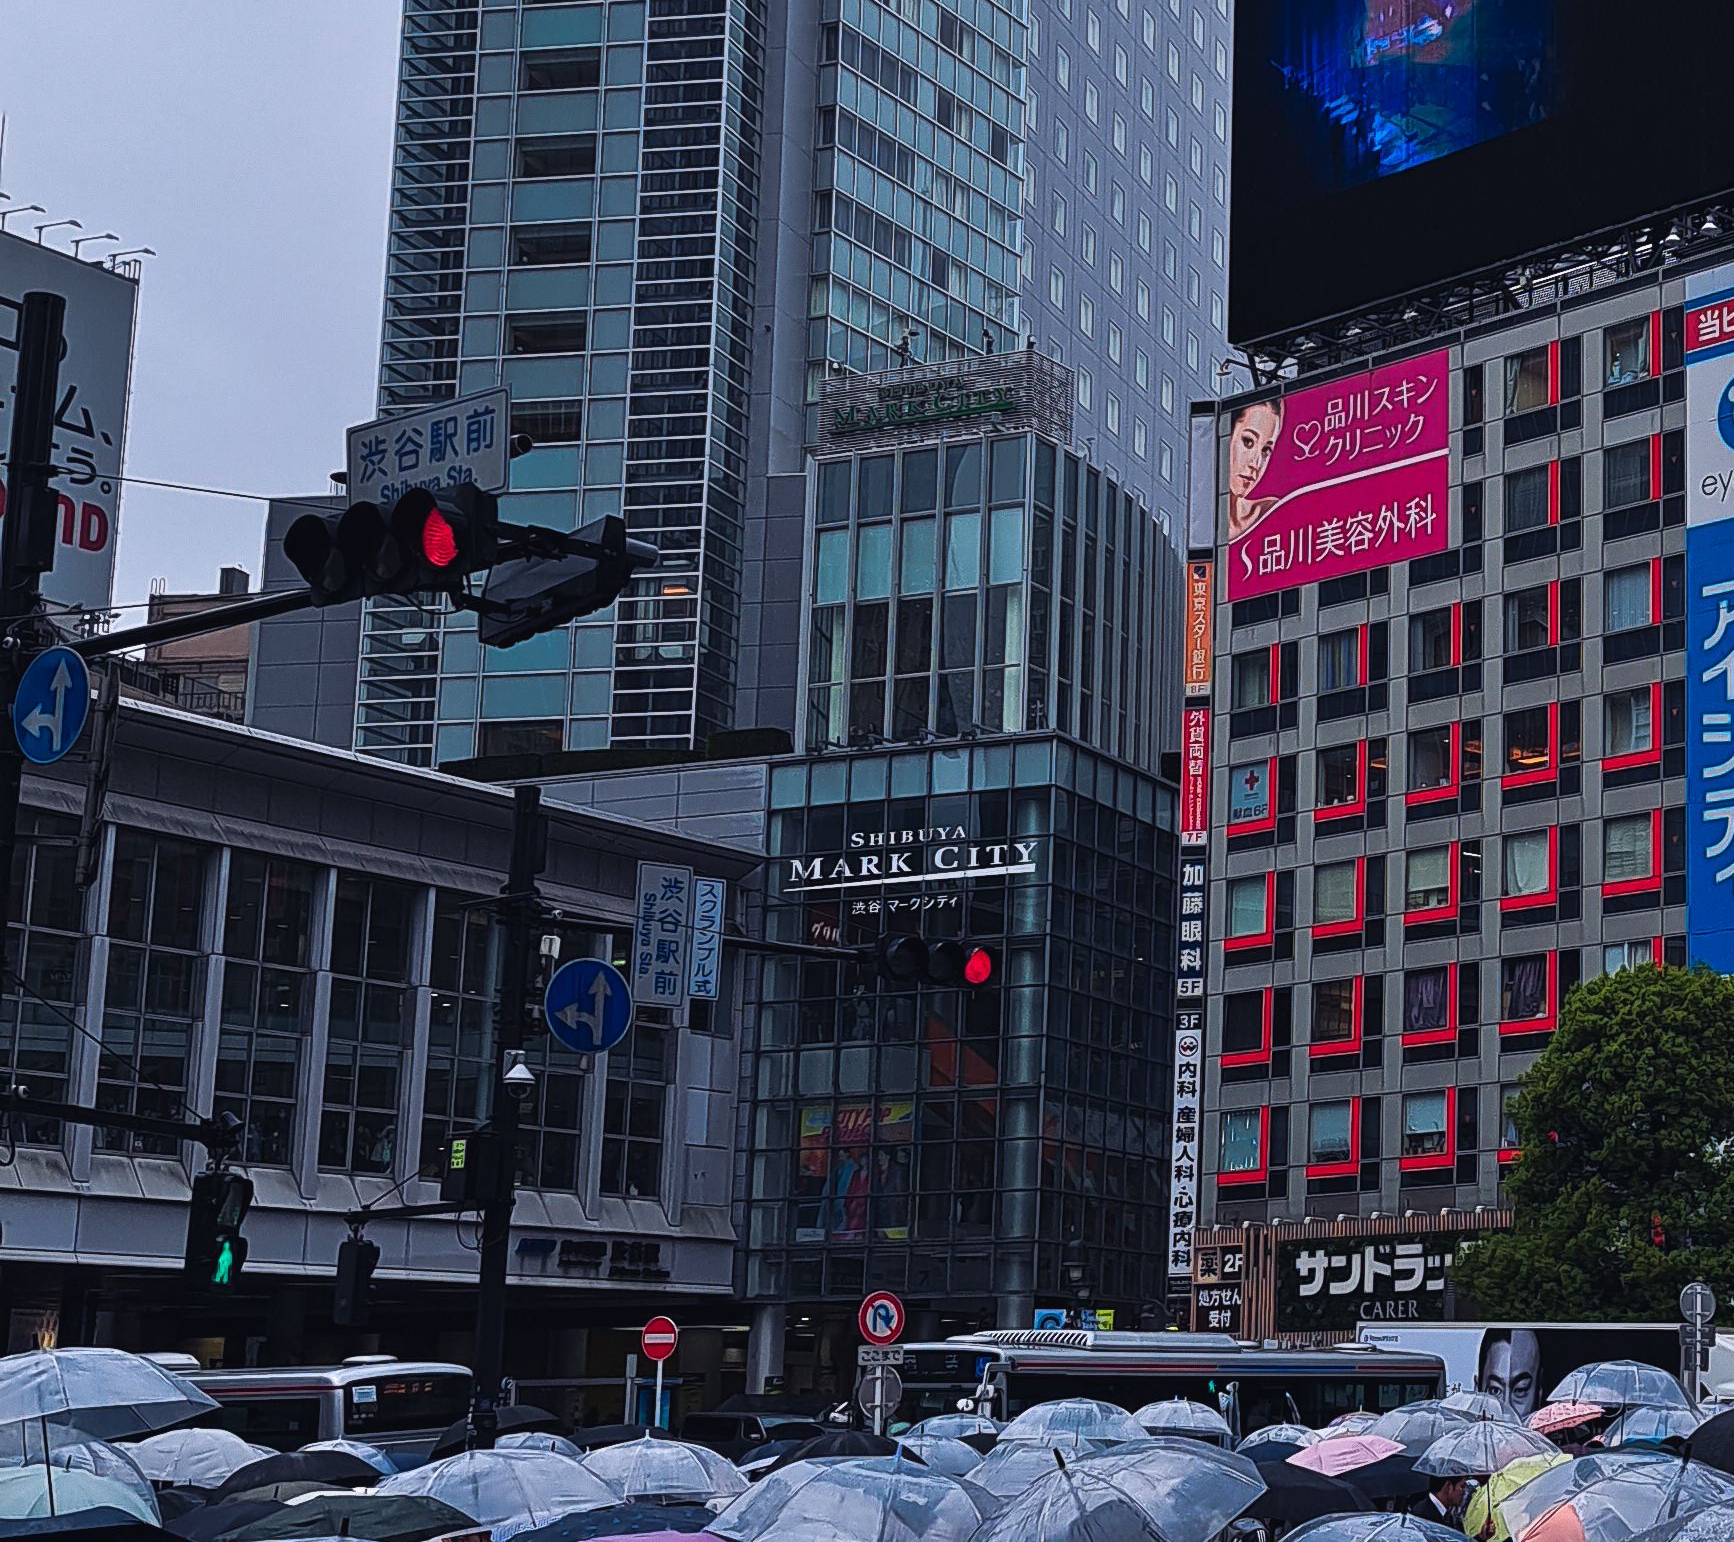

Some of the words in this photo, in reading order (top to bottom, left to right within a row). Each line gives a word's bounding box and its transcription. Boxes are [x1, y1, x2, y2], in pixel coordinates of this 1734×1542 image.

[1324, 375, 1438, 432] 品川スキン
[360, 405, 496, 484] 渋谷駅前
[1325, 412, 1425, 467] クリニック
[1259, 493, 1437, 576] 品川美容外科
[851, 825, 967, 848] SHIBUYA
[789, 852, 913, 882] MARK
[934, 842, 1039, 870] CITY
[851, 901, 881, 915] 渋谷
[887, 896, 958, 912] マークシティ
[1180, 864, 1204, 971] 加藤眼科
[655, 877, 685, 996] 渋谷駅前
[694, 884, 717, 994] スクランブル式
[1180, 981, 1200, 994] 5F
[1179, 1015, 1200, 1029] 3F
[1176, 1061, 1197, 1098] 内科
[1174, 1106, 1196, 1183] 産婦人科
[1224, 1253, 1244, 1273] 2F
[1199, 1288, 1243, 1307] 処方せん
[1360, 1300, 1419, 1319] CARER
[1208, 1310, 1231, 1329] 受付
